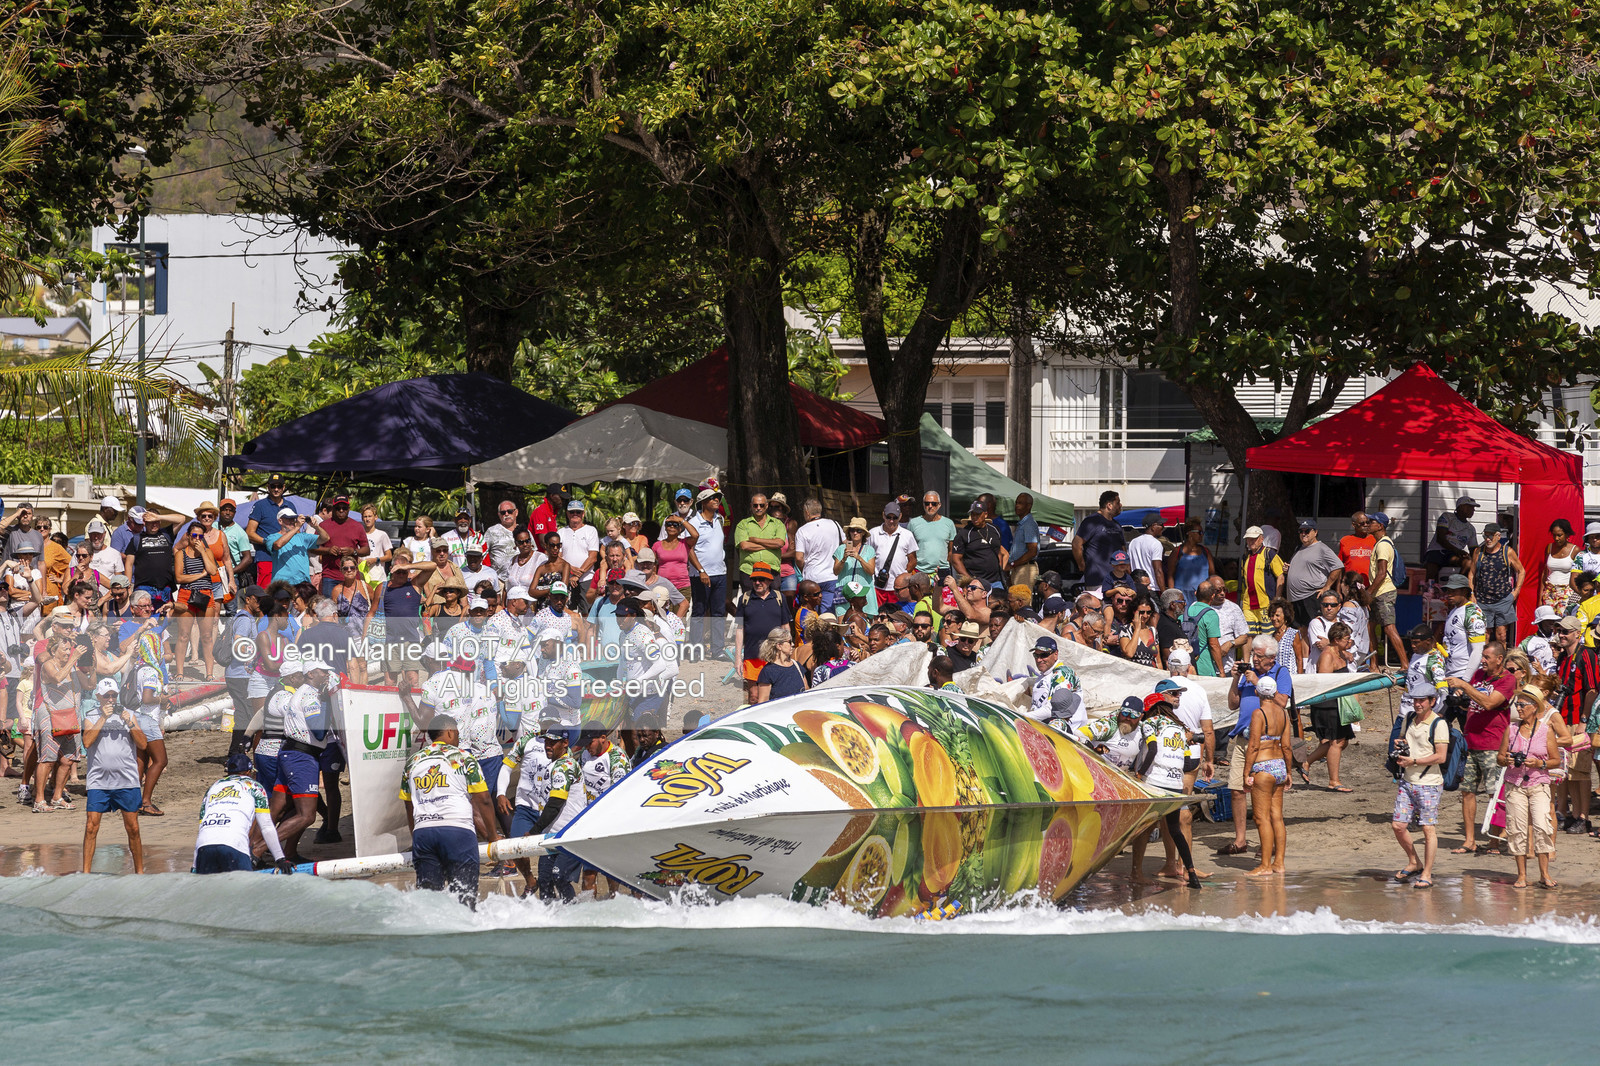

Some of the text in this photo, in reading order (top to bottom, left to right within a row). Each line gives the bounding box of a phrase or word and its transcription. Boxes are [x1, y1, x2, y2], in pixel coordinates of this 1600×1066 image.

[443, 698, 460, 710] UFR
[471, 707, 488, 719] UFR
[523, 700, 541, 712] UFR
[363, 713, 414, 751] UFR
[413, 772, 450, 794] ROYAL
[640, 752, 752, 808] ROYAL
[208, 788, 242, 804] ROYAL
[704, 778, 791, 814] Fruits de Martinique
[202, 819, 231, 827] ADEP
[650, 842, 764, 896] ROYAL
